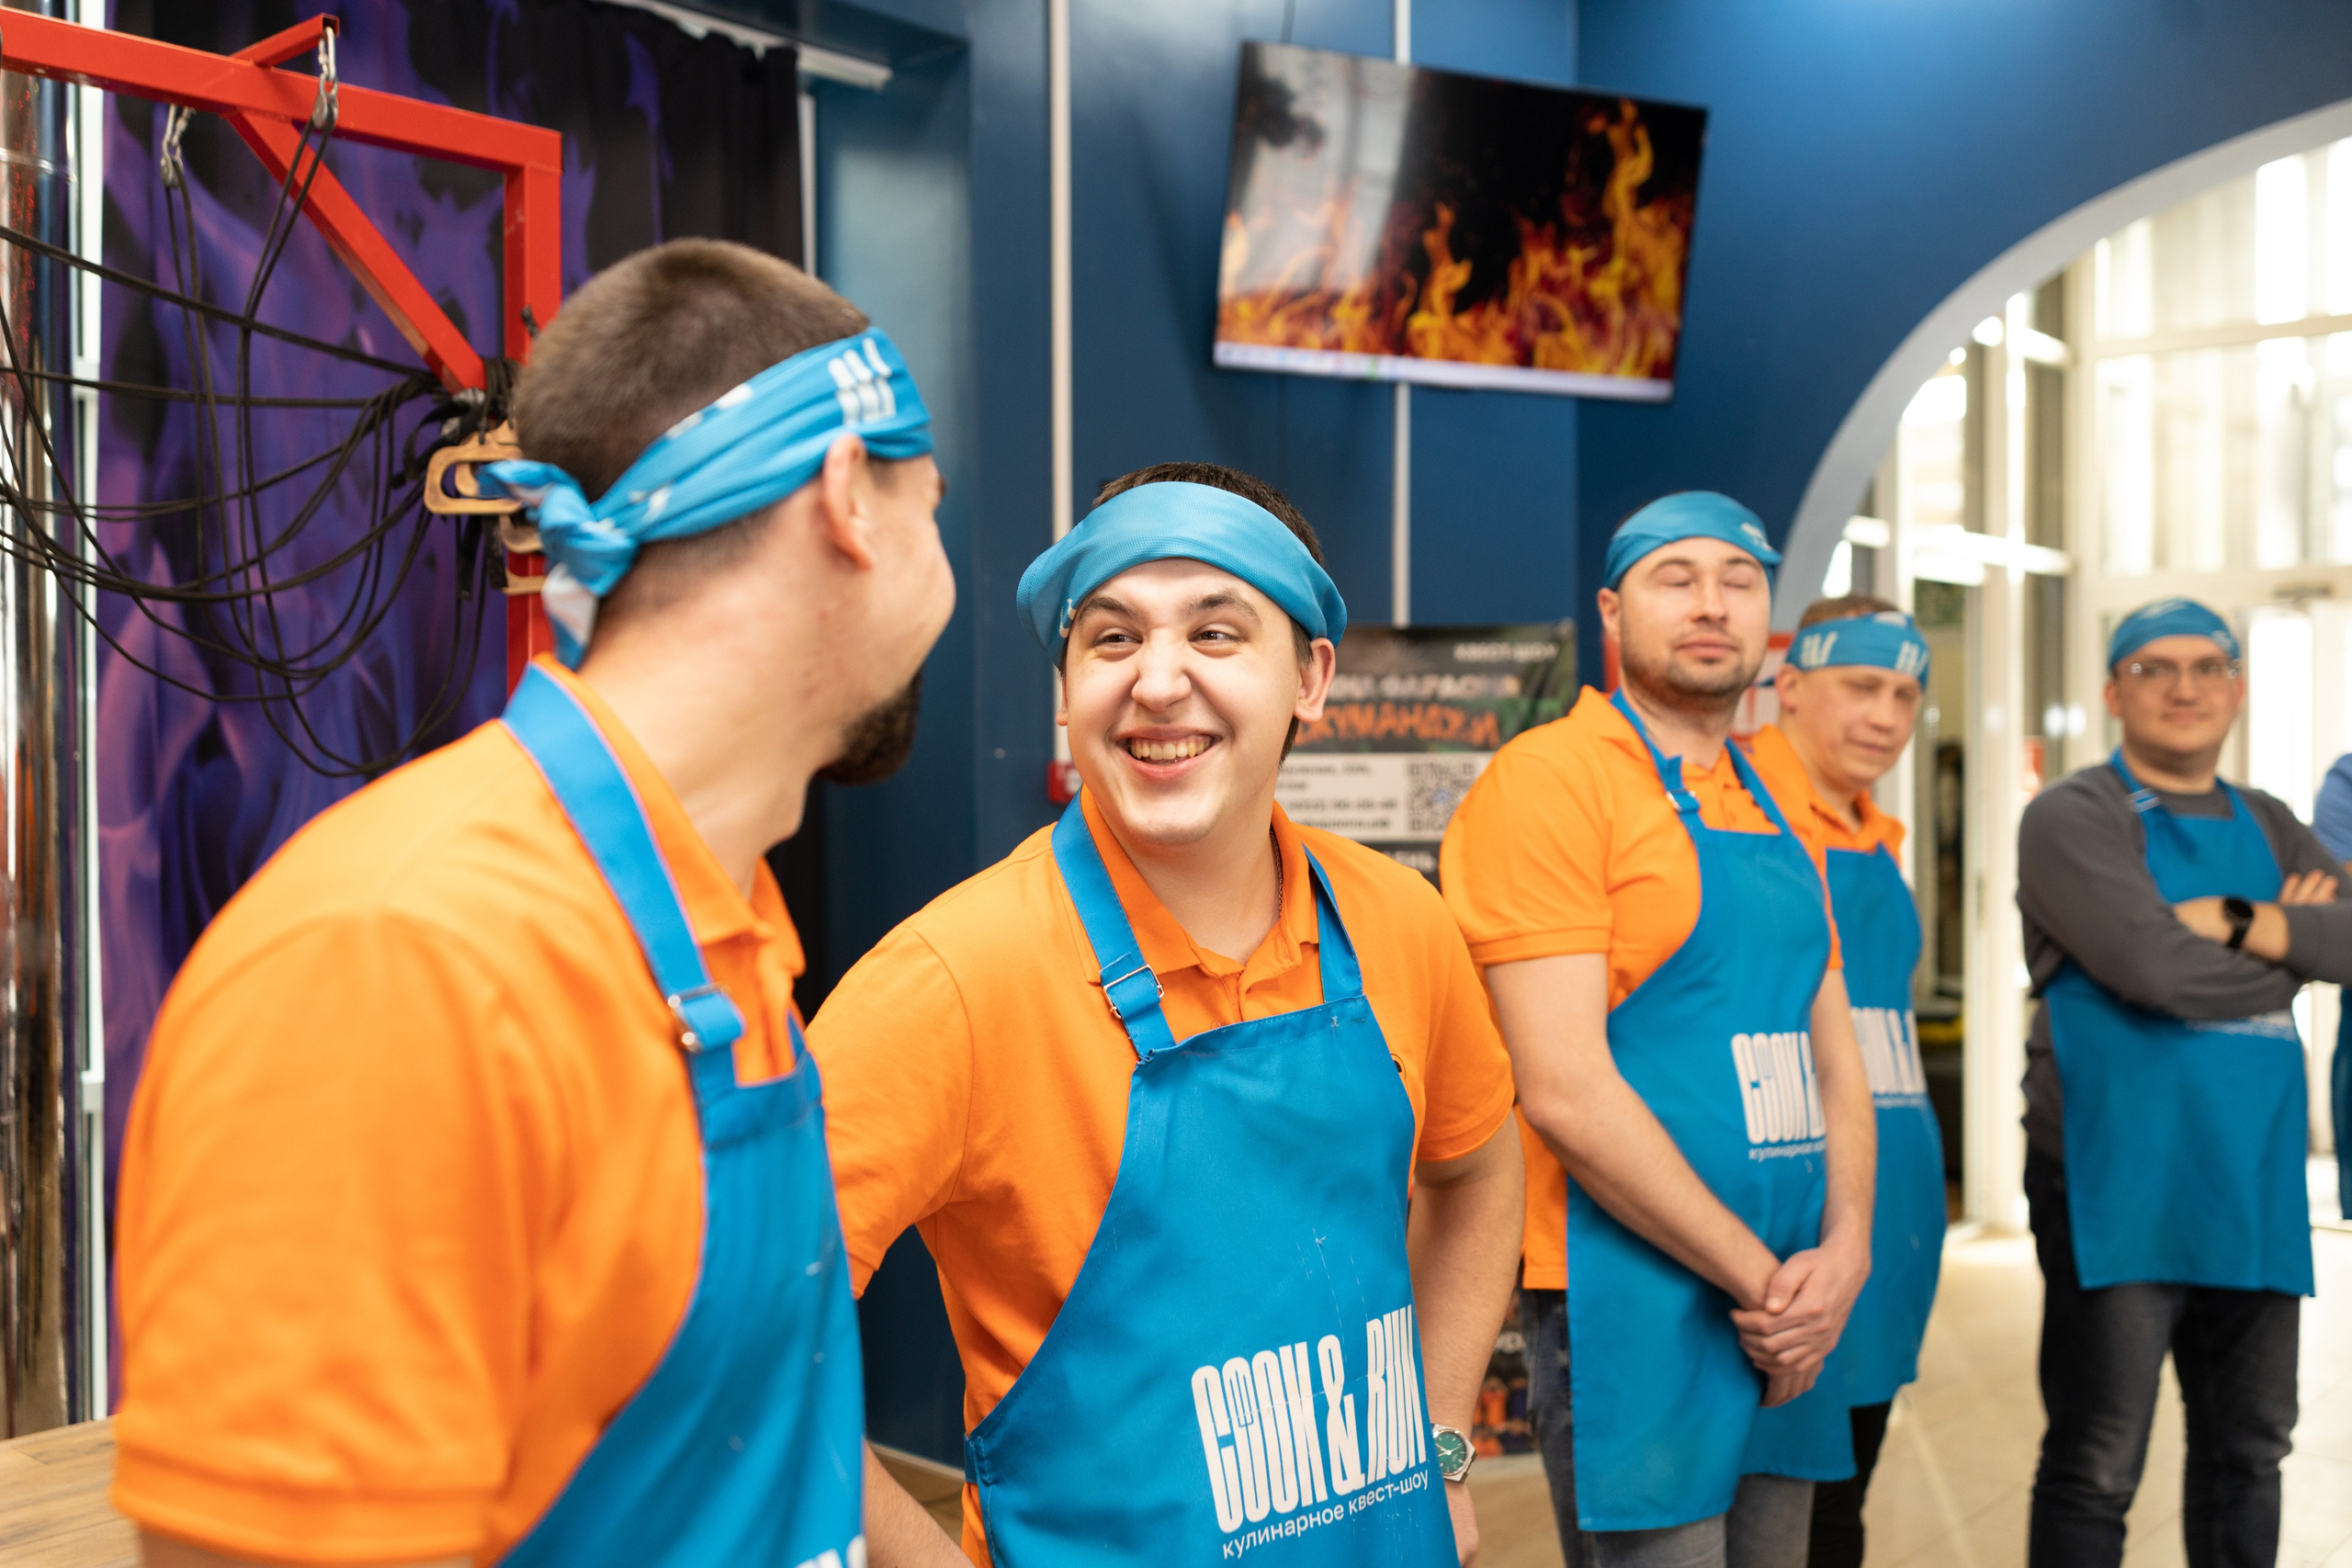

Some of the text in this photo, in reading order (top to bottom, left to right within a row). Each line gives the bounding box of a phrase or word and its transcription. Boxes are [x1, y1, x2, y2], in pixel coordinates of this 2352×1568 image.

[1731, 1032, 1808, 1145] COOK
[1191, 1340, 1329, 1534] COOK
[1317, 1334, 1366, 1497] &
[1222, 1469, 1429, 1560] кулинарное квест-шоу
